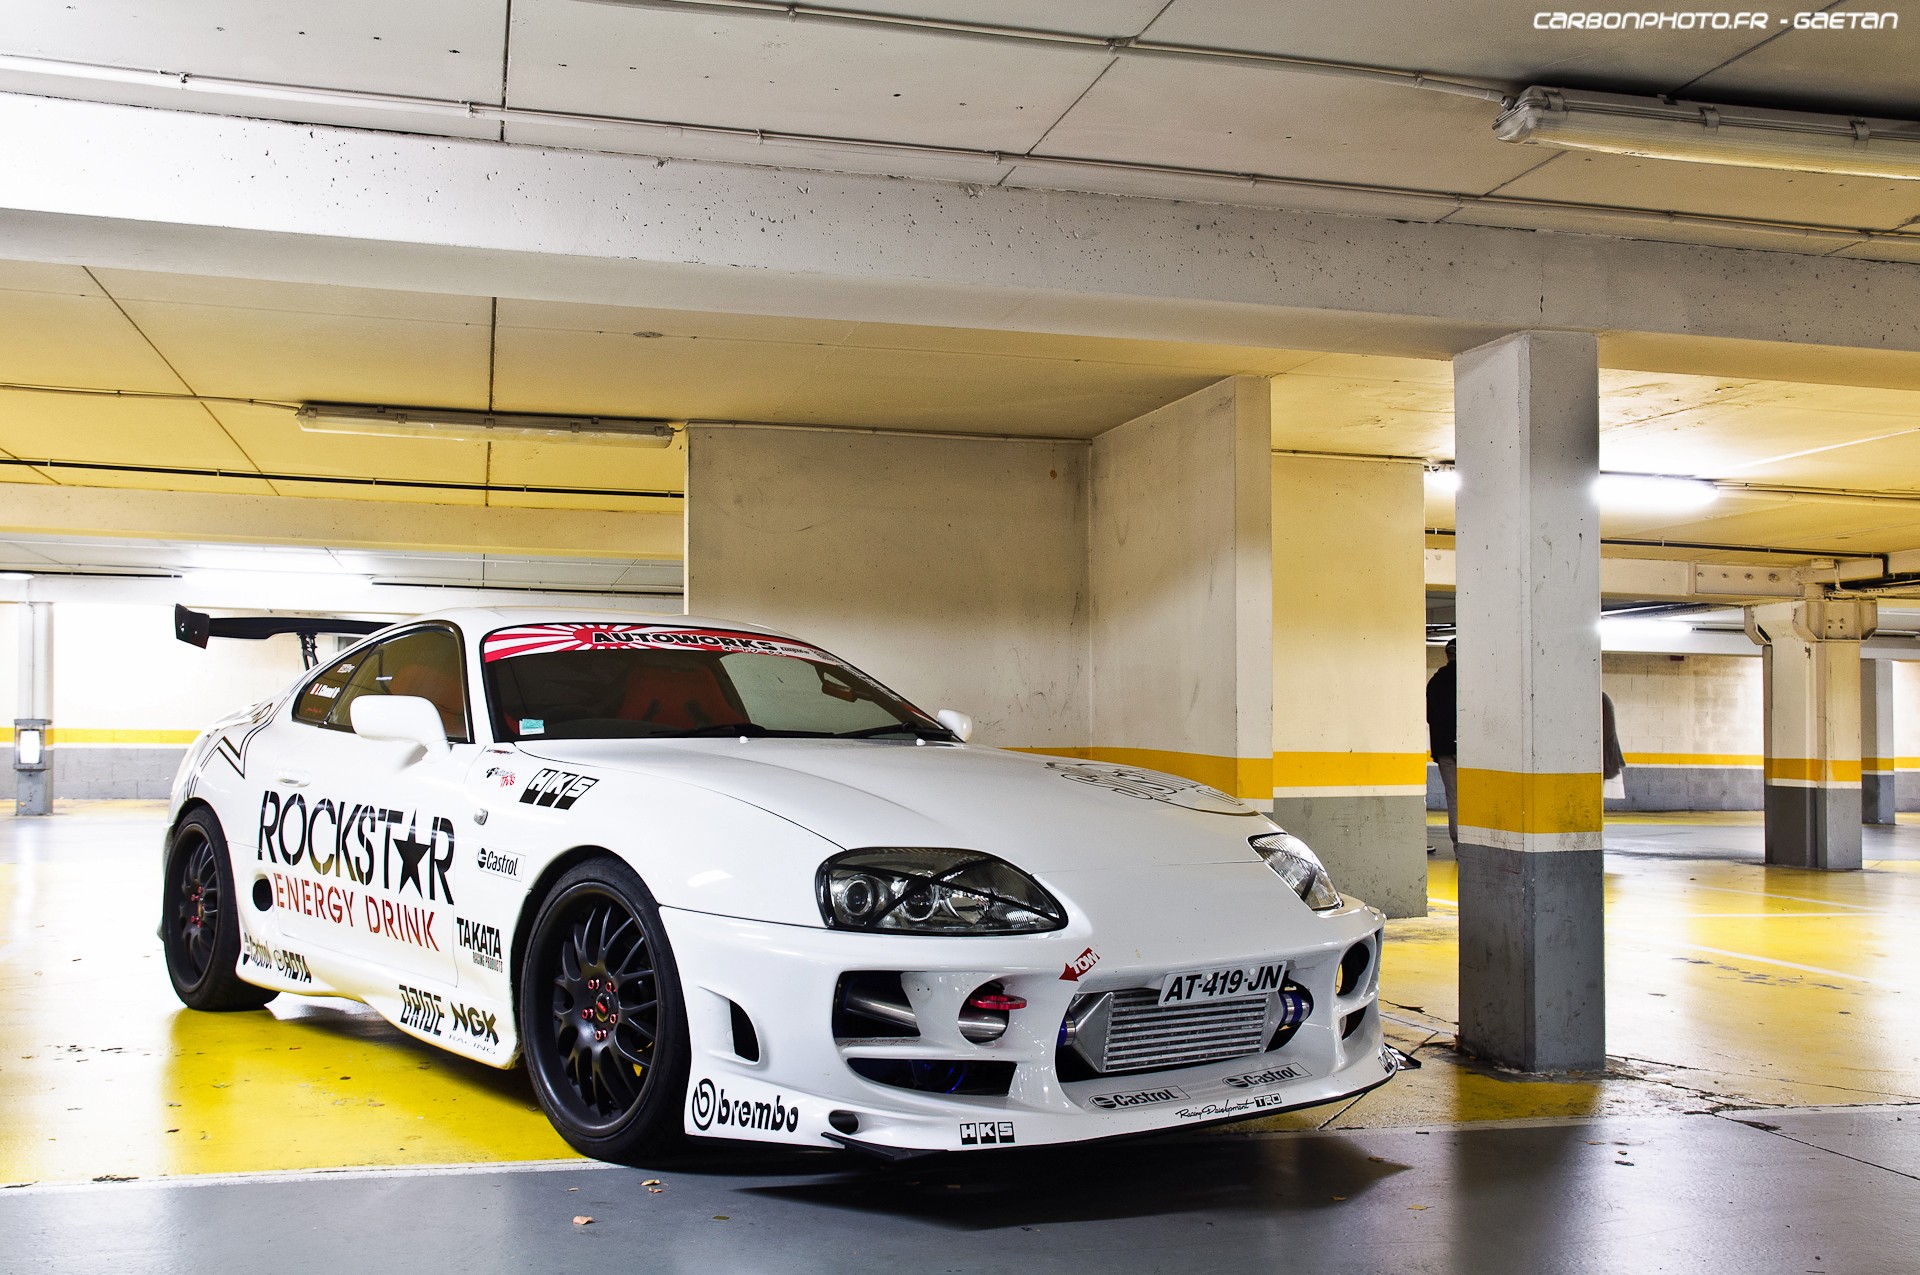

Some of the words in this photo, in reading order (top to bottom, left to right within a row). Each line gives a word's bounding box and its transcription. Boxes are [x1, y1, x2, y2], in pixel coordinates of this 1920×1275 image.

[594, 632, 778, 651] AUTOWORKS
[519, 768, 600, 810] HKS
[487, 850, 519, 876] Castrol
[273, 872, 355, 928] ENERGY
[366, 896, 440, 952] DRINK
[456, 917, 502, 959] TAKATA
[1072, 950, 1100, 974] TOW
[450, 1001, 500, 1046] NGK
[448, 1034, 496, 1055] RACING
[1242, 1066, 1302, 1087] Castrol
[1112, 1087, 1175, 1107] Castrol
[717, 1089, 799, 1133] brembo
[960, 1121, 1016, 1145] HKS
